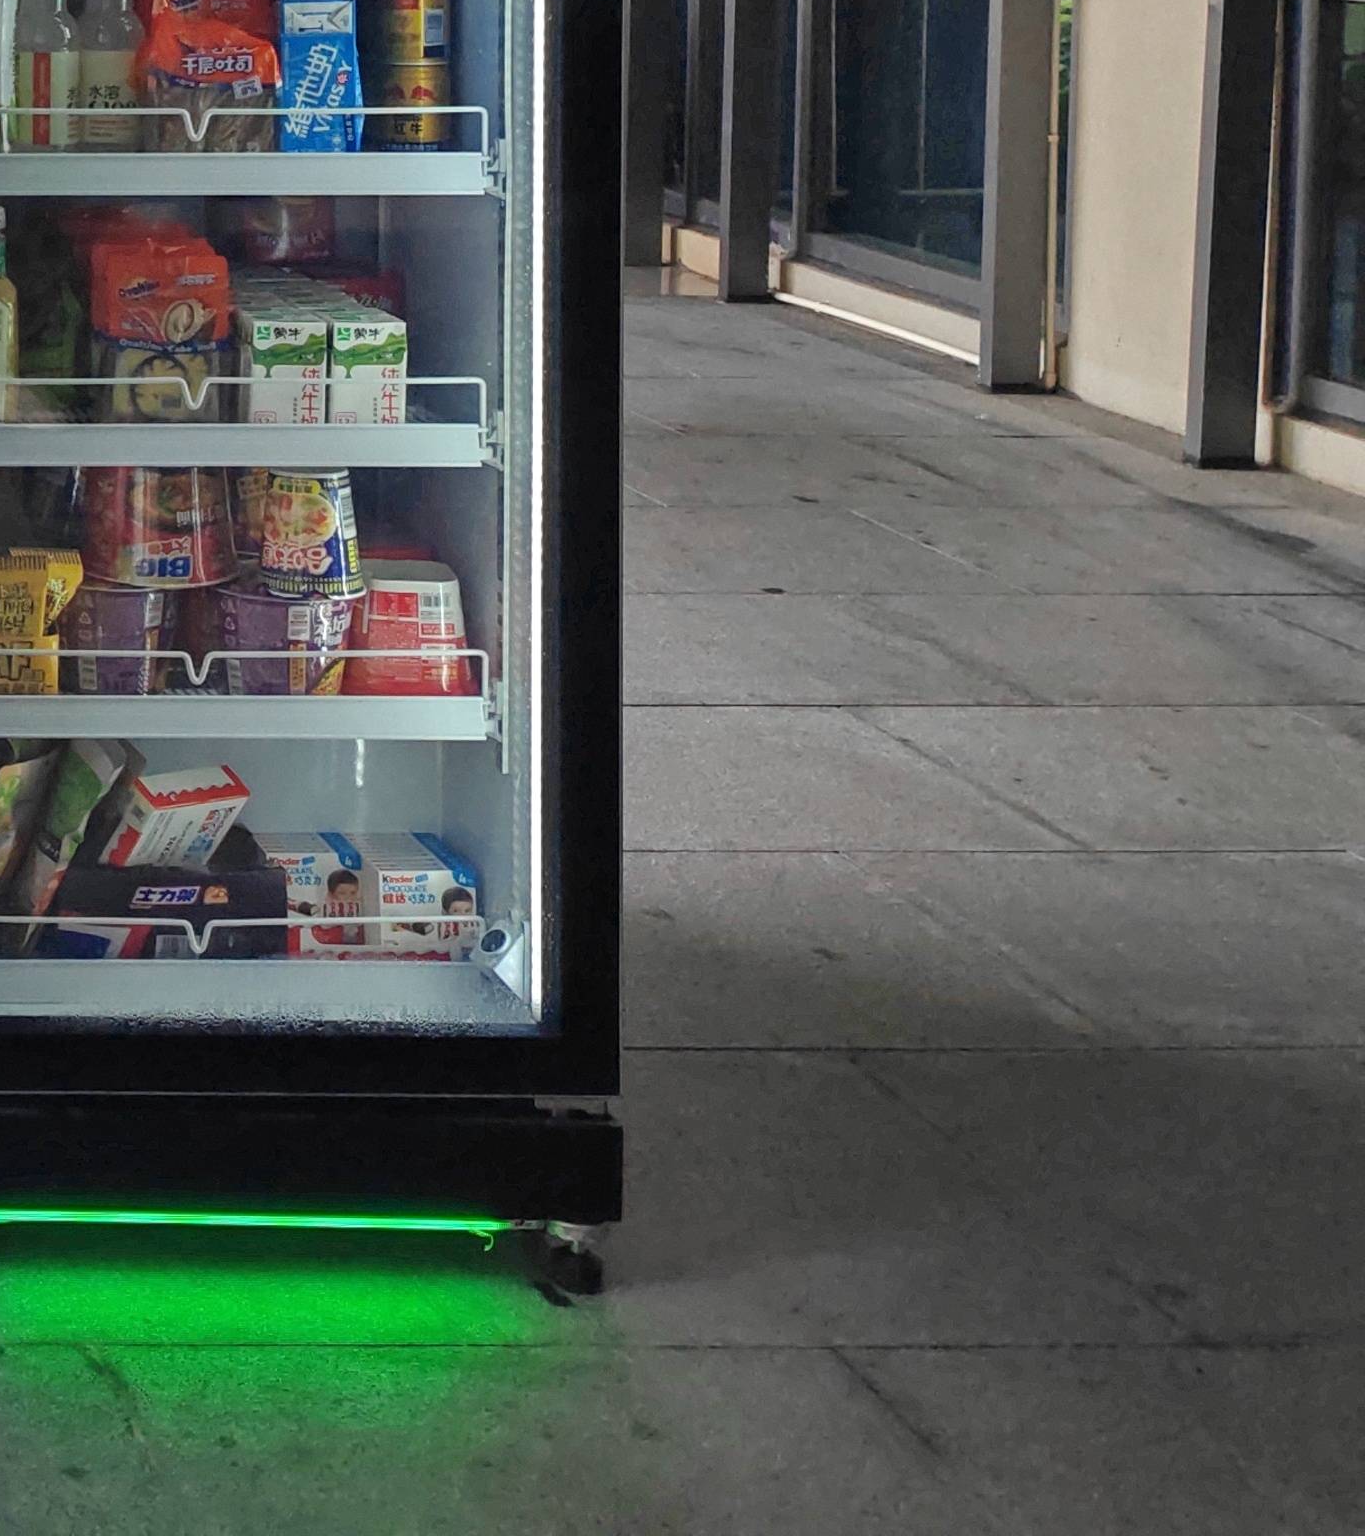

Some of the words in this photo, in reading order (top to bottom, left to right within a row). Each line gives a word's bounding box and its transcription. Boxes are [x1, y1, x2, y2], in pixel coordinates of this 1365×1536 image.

[182, 54, 253, 76] 千层吐司
[89, 85, 121, 100] 水溶
[138, 888, 198, 904] 士力架
